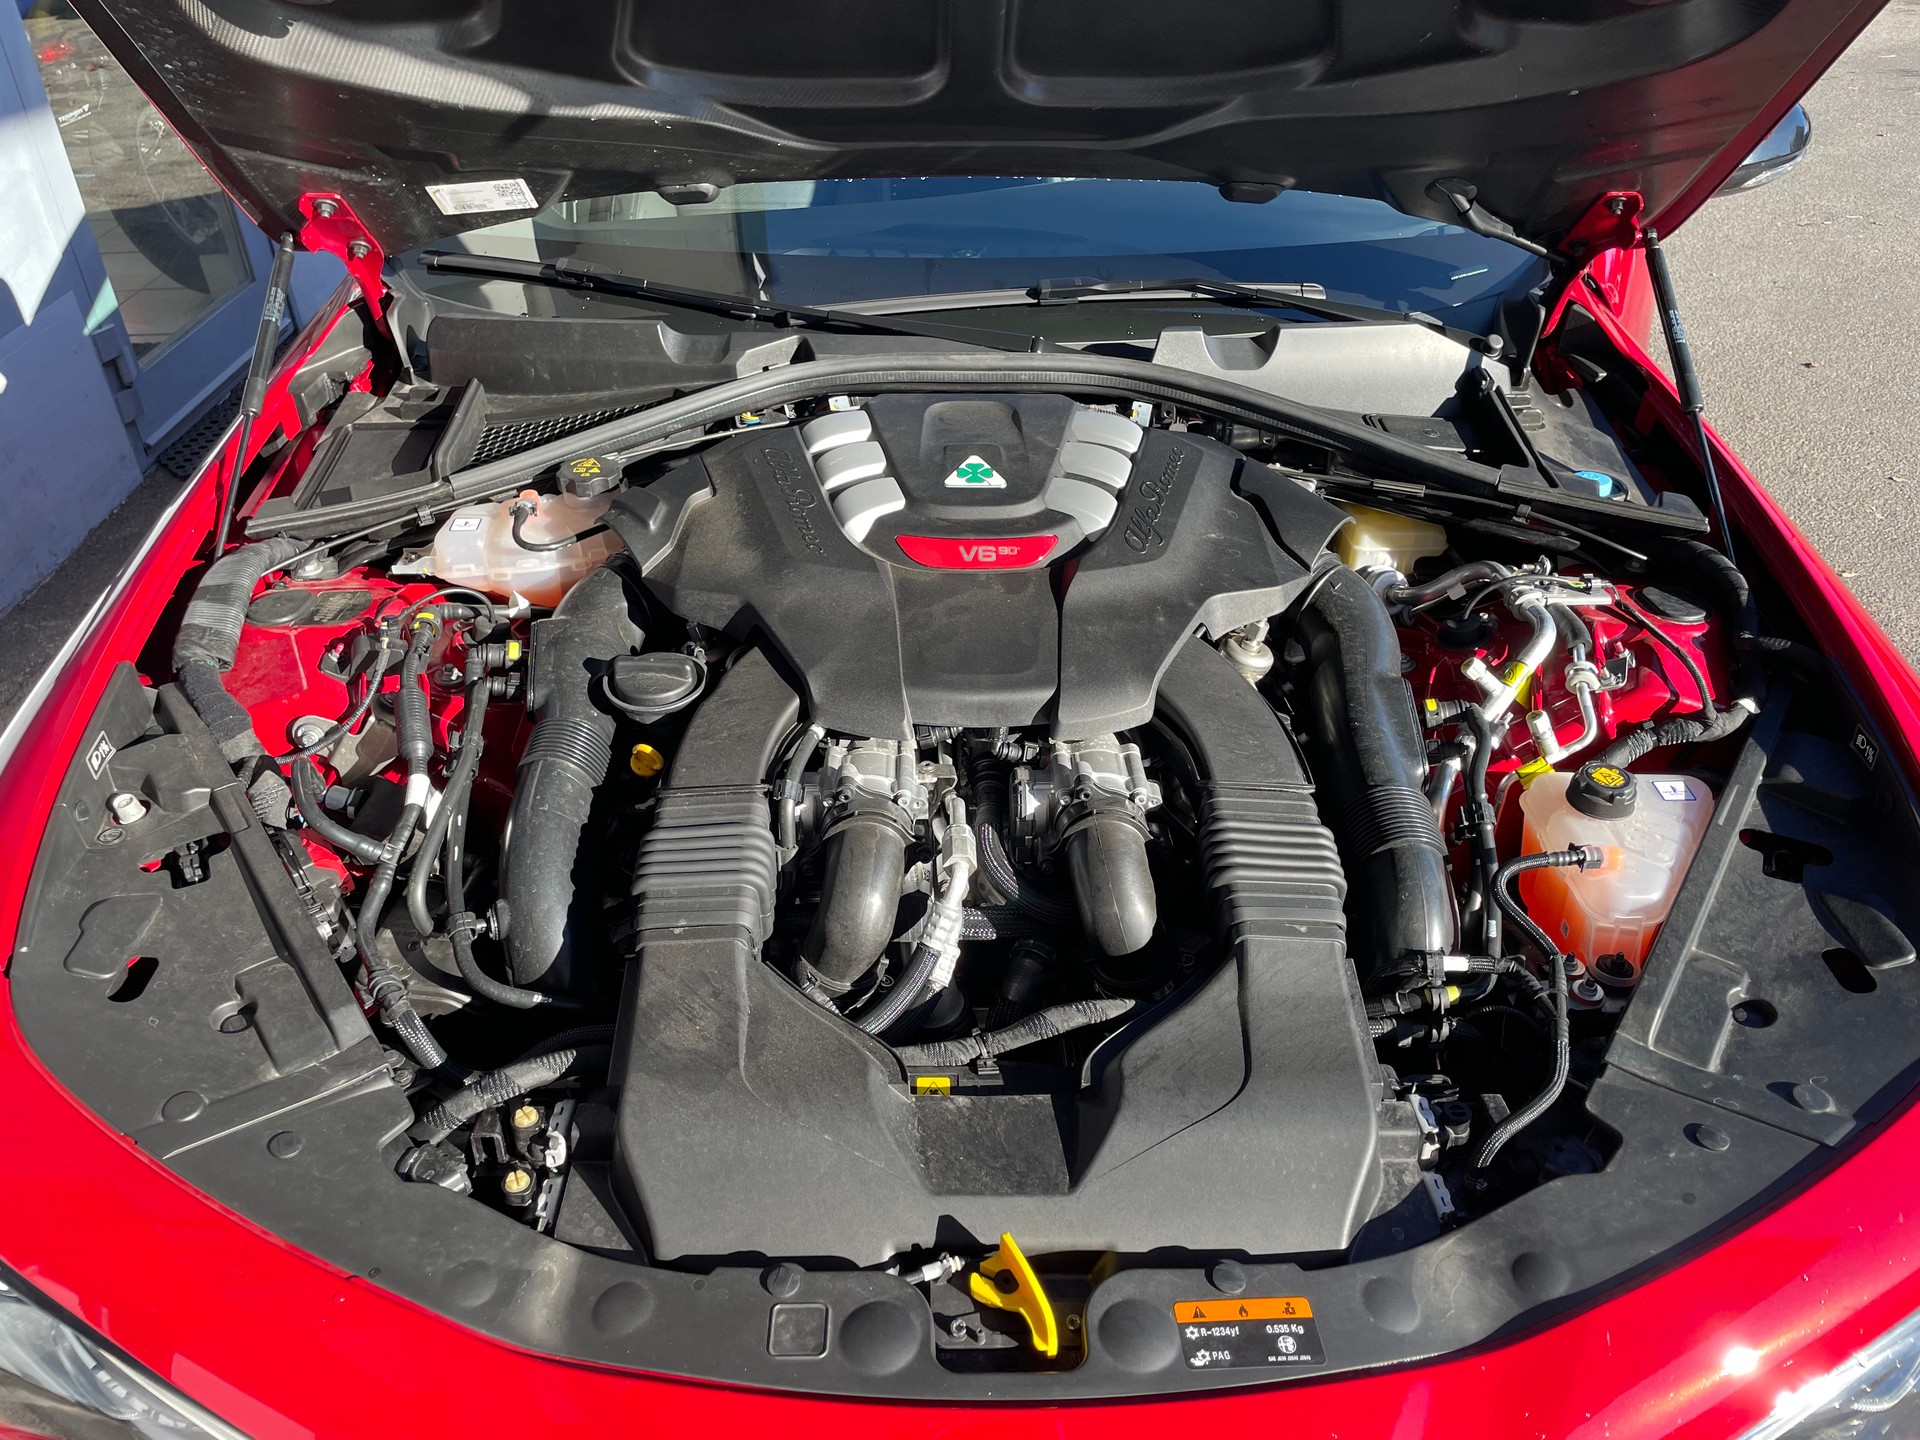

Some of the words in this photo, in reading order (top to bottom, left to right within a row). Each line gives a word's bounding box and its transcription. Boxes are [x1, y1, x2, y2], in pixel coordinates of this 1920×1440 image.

[1140, 445, 1185, 506] Romeo
[1123, 505, 1165, 555] Alfa
[958, 545, 997, 562] V6
[1200, 1325, 1240, 1338] R-1234yf
[1291, 1323, 1305, 1336] Kg
[1212, 1350, 1231, 1361] PAG
